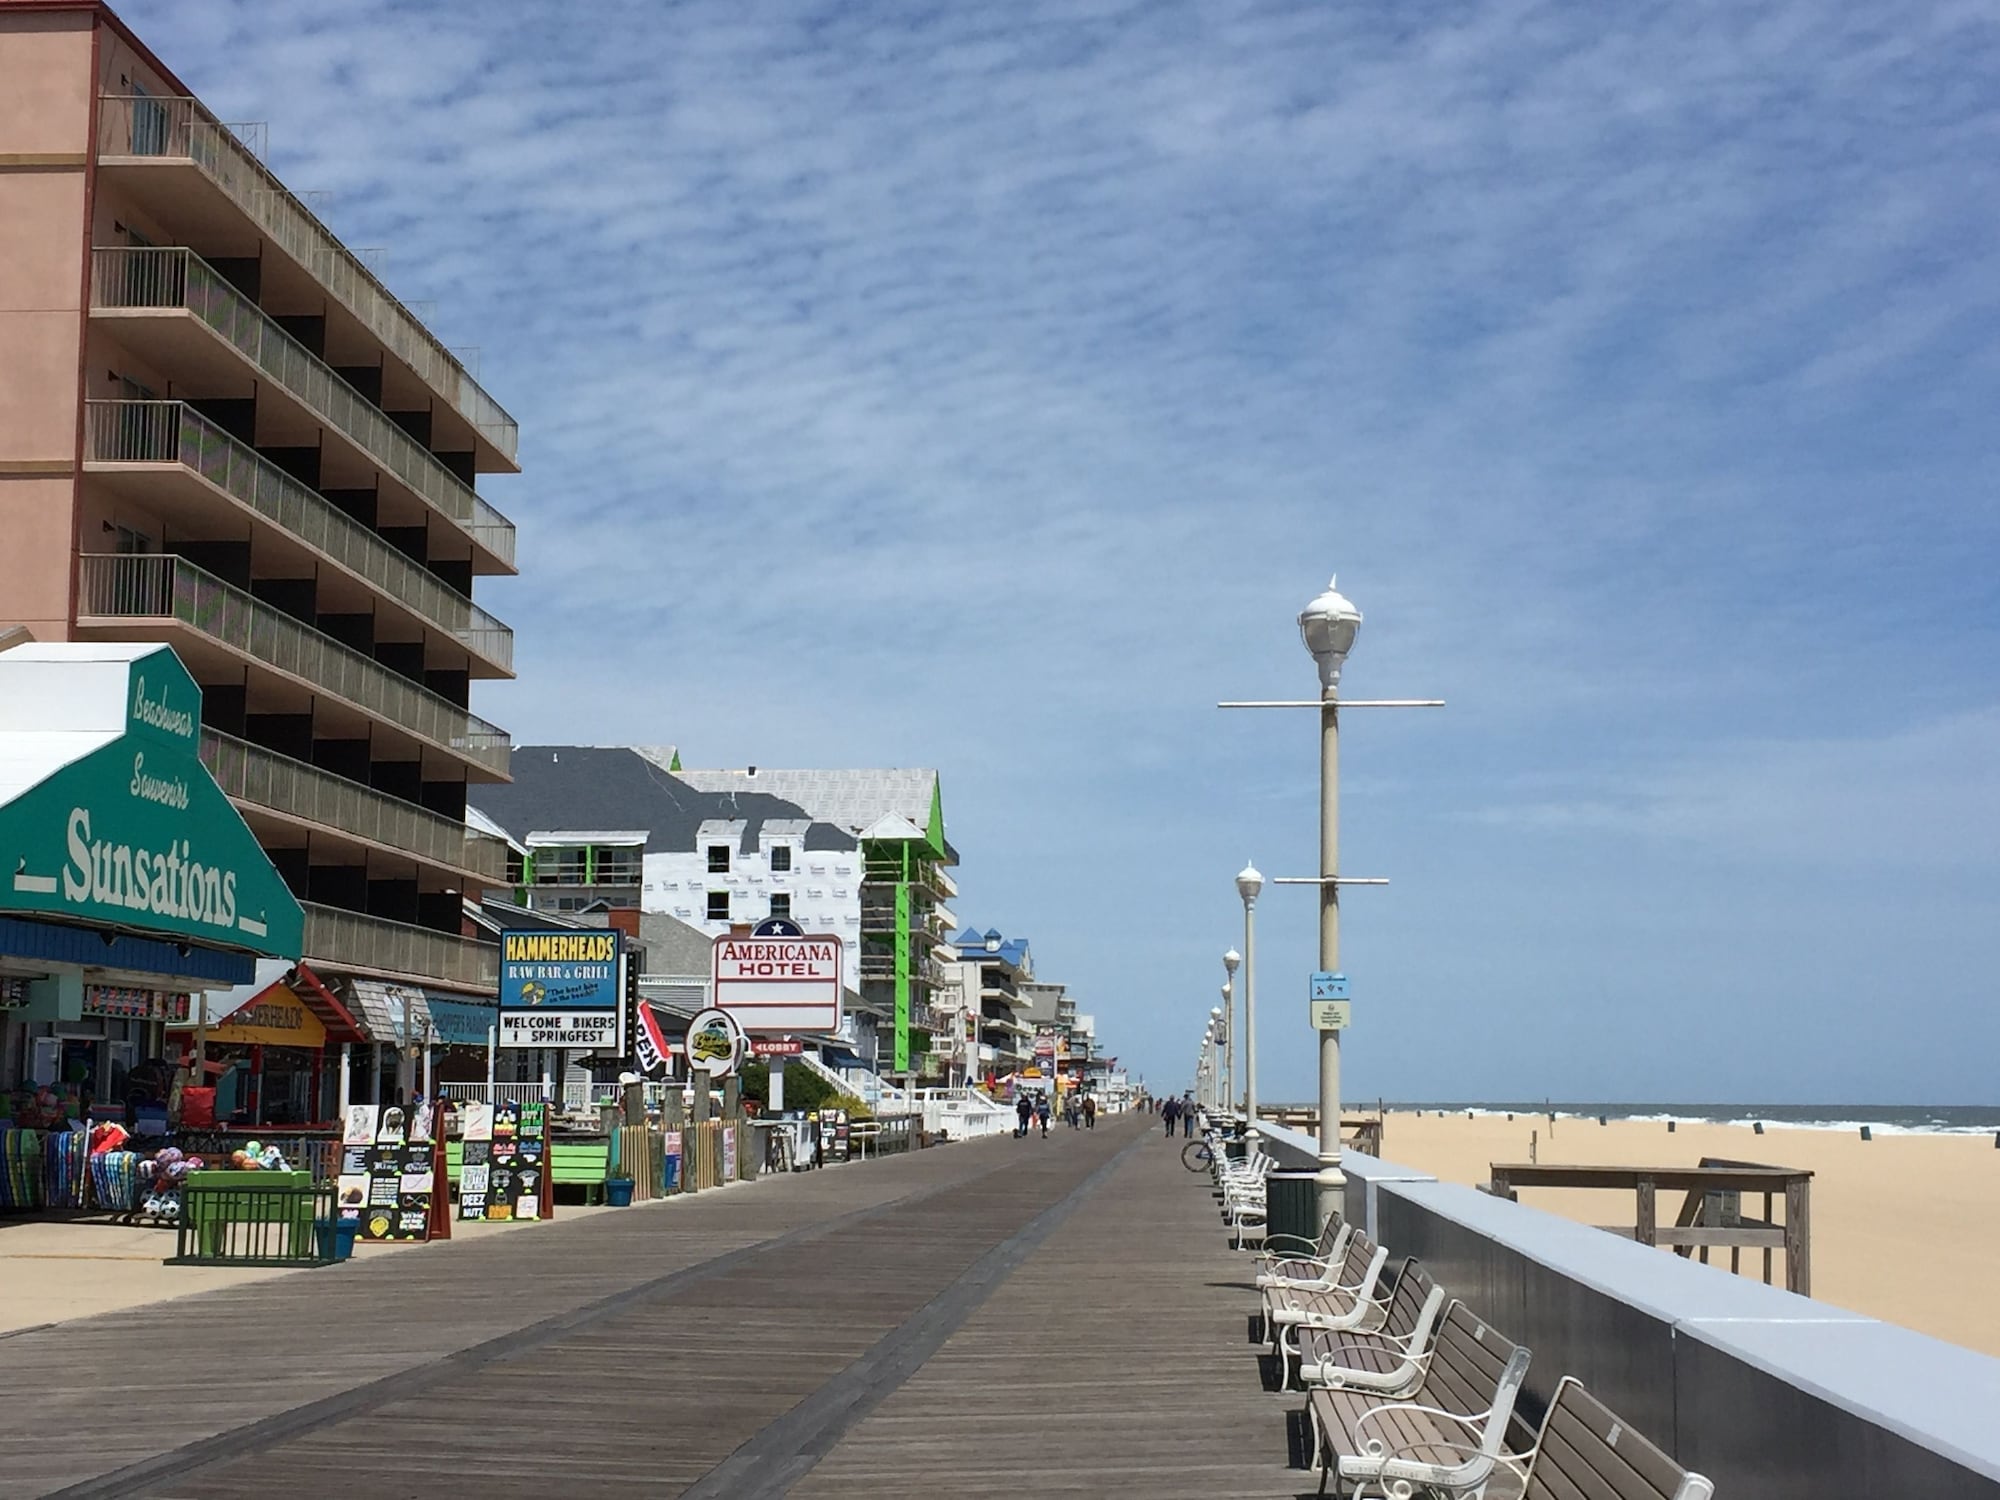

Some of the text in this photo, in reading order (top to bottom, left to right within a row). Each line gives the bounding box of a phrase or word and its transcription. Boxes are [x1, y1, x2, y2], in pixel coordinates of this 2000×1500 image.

[133, 675, 194, 738] Beachwear
[130, 752, 189, 810] Souvenirs
[62, 806, 237, 929] Sunsations
[506, 935, 615, 962] HAMMERHEADS
[721, 941, 833, 961] AMERICANA
[509, 965, 534, 979] RAW
[537, 965, 562, 979] BAR
[574, 965, 609, 979] GRILL
[739, 963, 821, 976] HOTEL
[503, 1016, 562, 1029] WELCOME
[572, 1017, 615, 1029] BIKERS
[531, 1030, 605, 1042] SPRINGFEST
[762, 1043, 798, 1051] LOBBY
[462, 1193, 486, 1207] DEEZ
